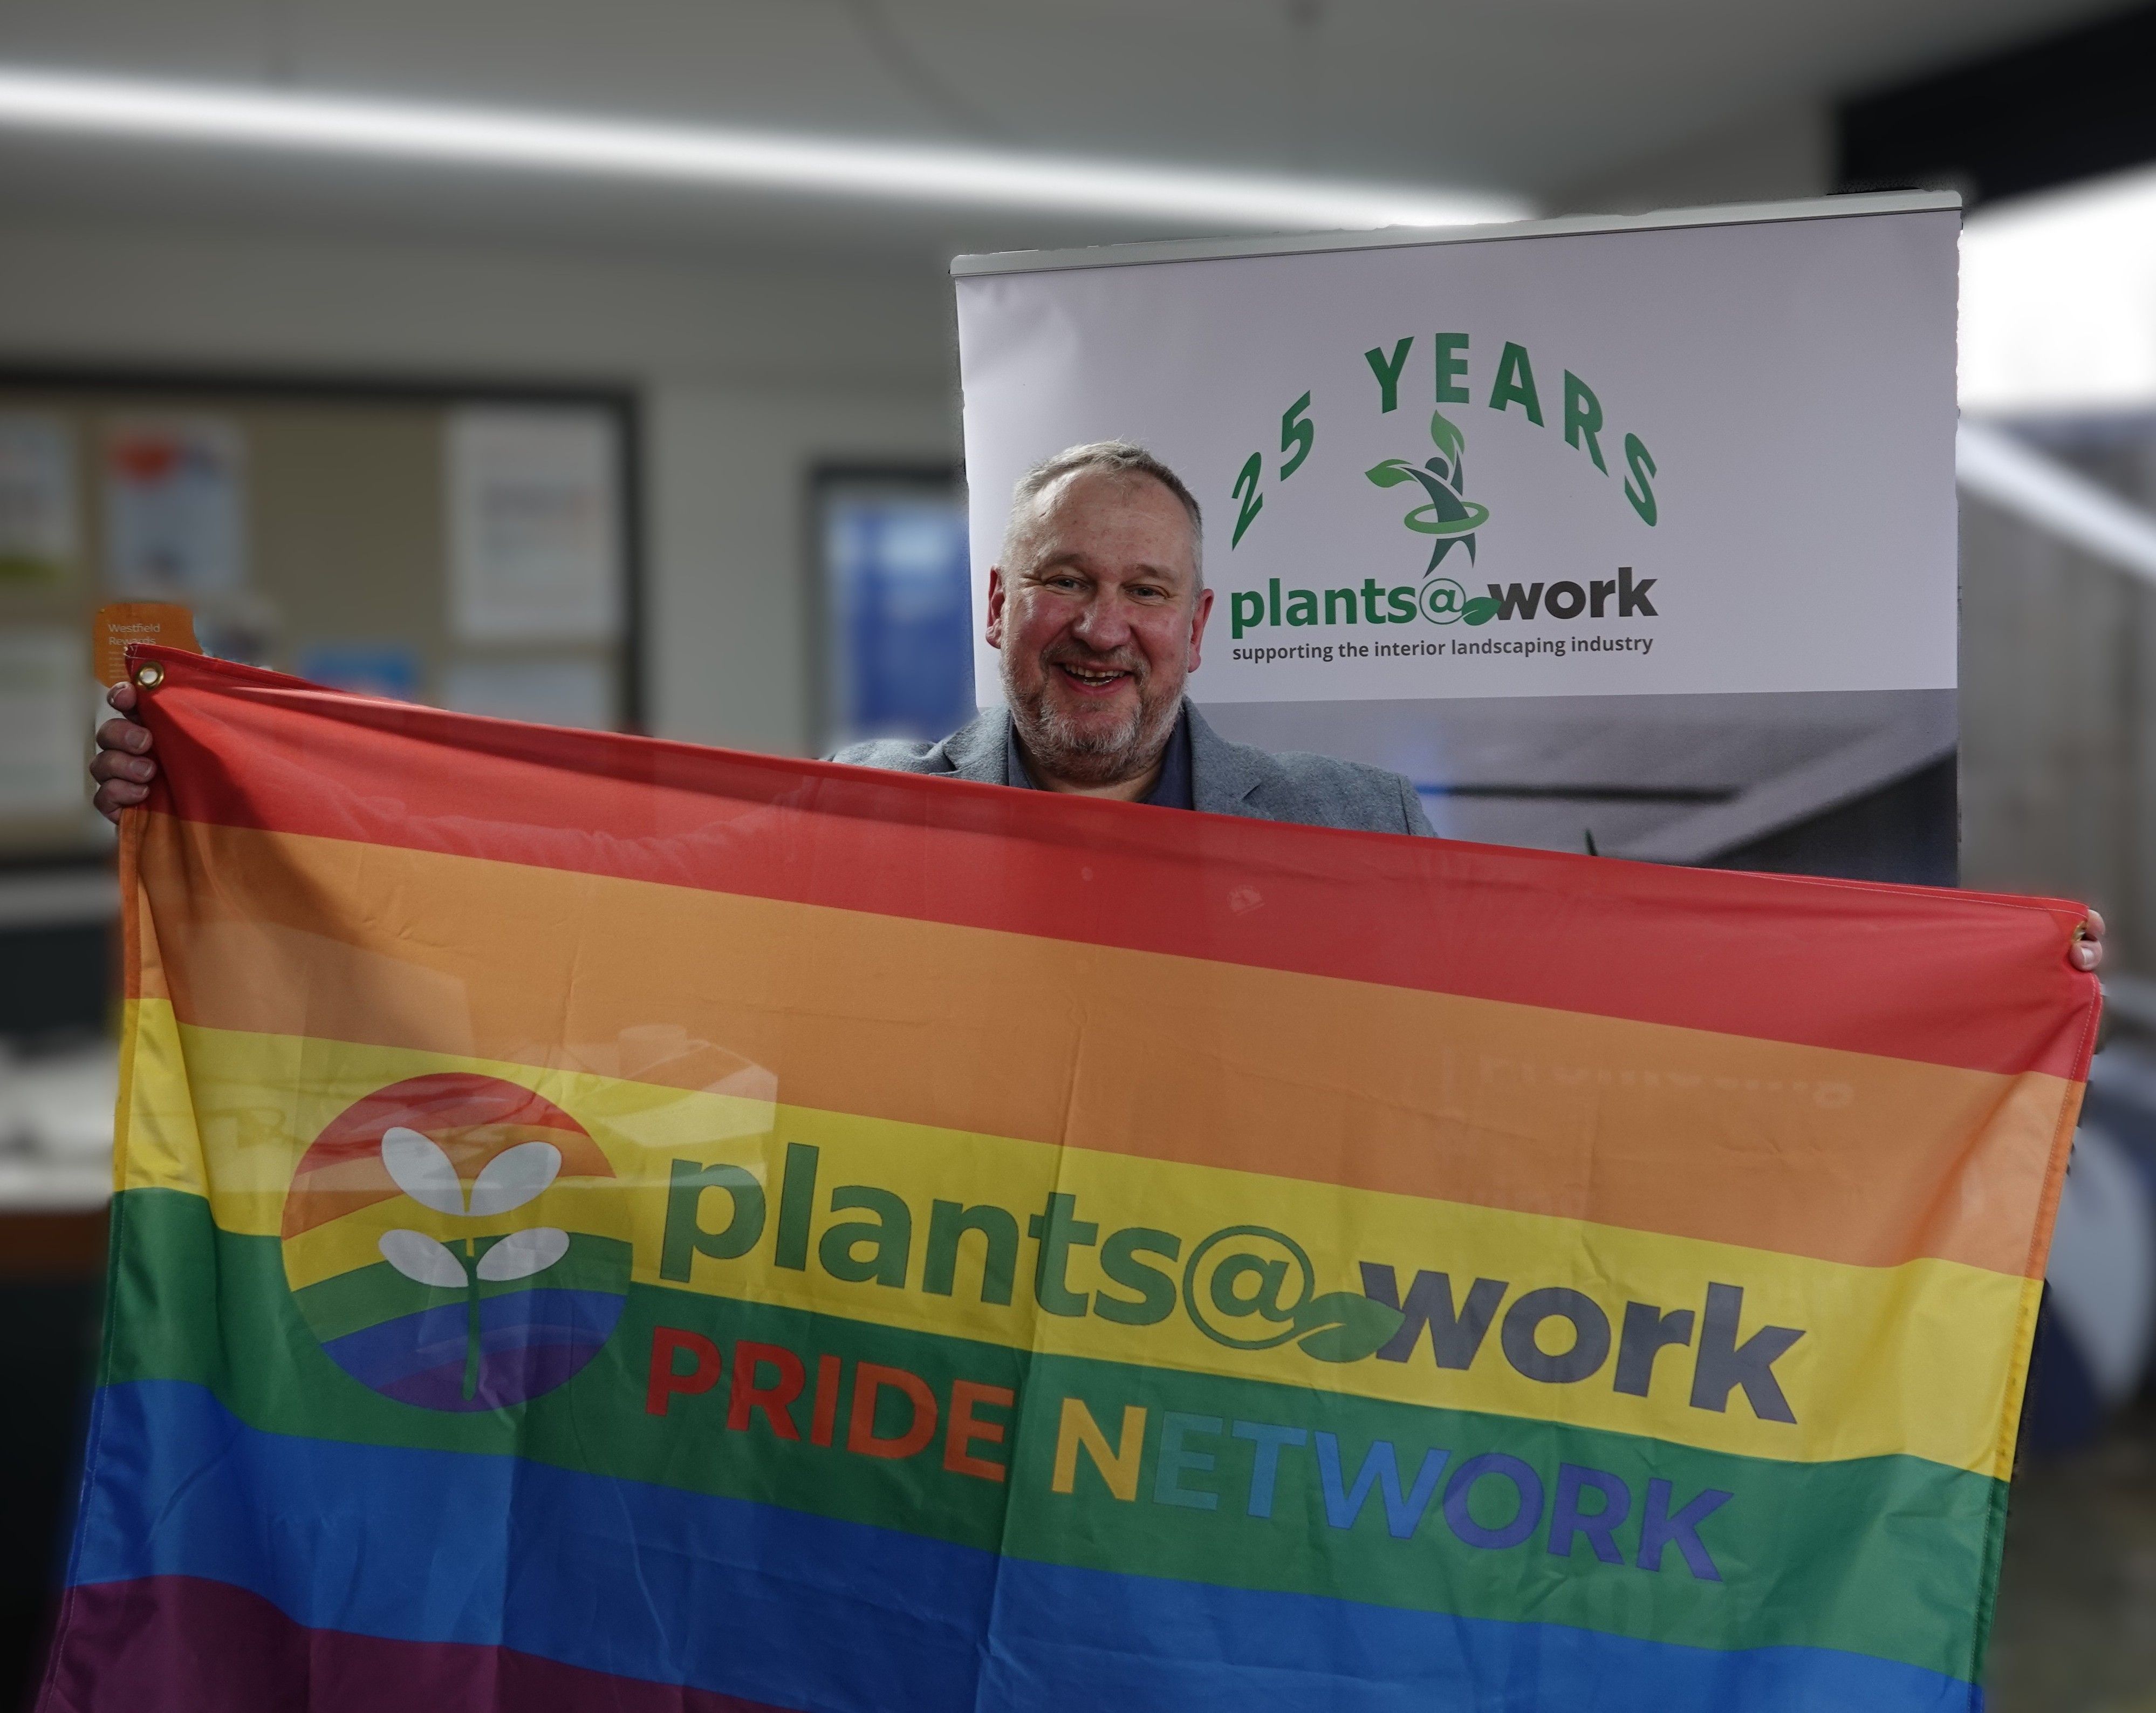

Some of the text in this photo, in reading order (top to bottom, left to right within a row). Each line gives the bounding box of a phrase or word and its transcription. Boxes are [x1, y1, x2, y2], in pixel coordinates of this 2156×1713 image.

[1231, 332, 1658, 552] 25 YEARS
[108, 623, 160, 632] Westfield
[1233, 636, 1654, 664] supporting the interior landscaping industry
[646, 1325, 1735, 1582] PRIDE NETWORK
